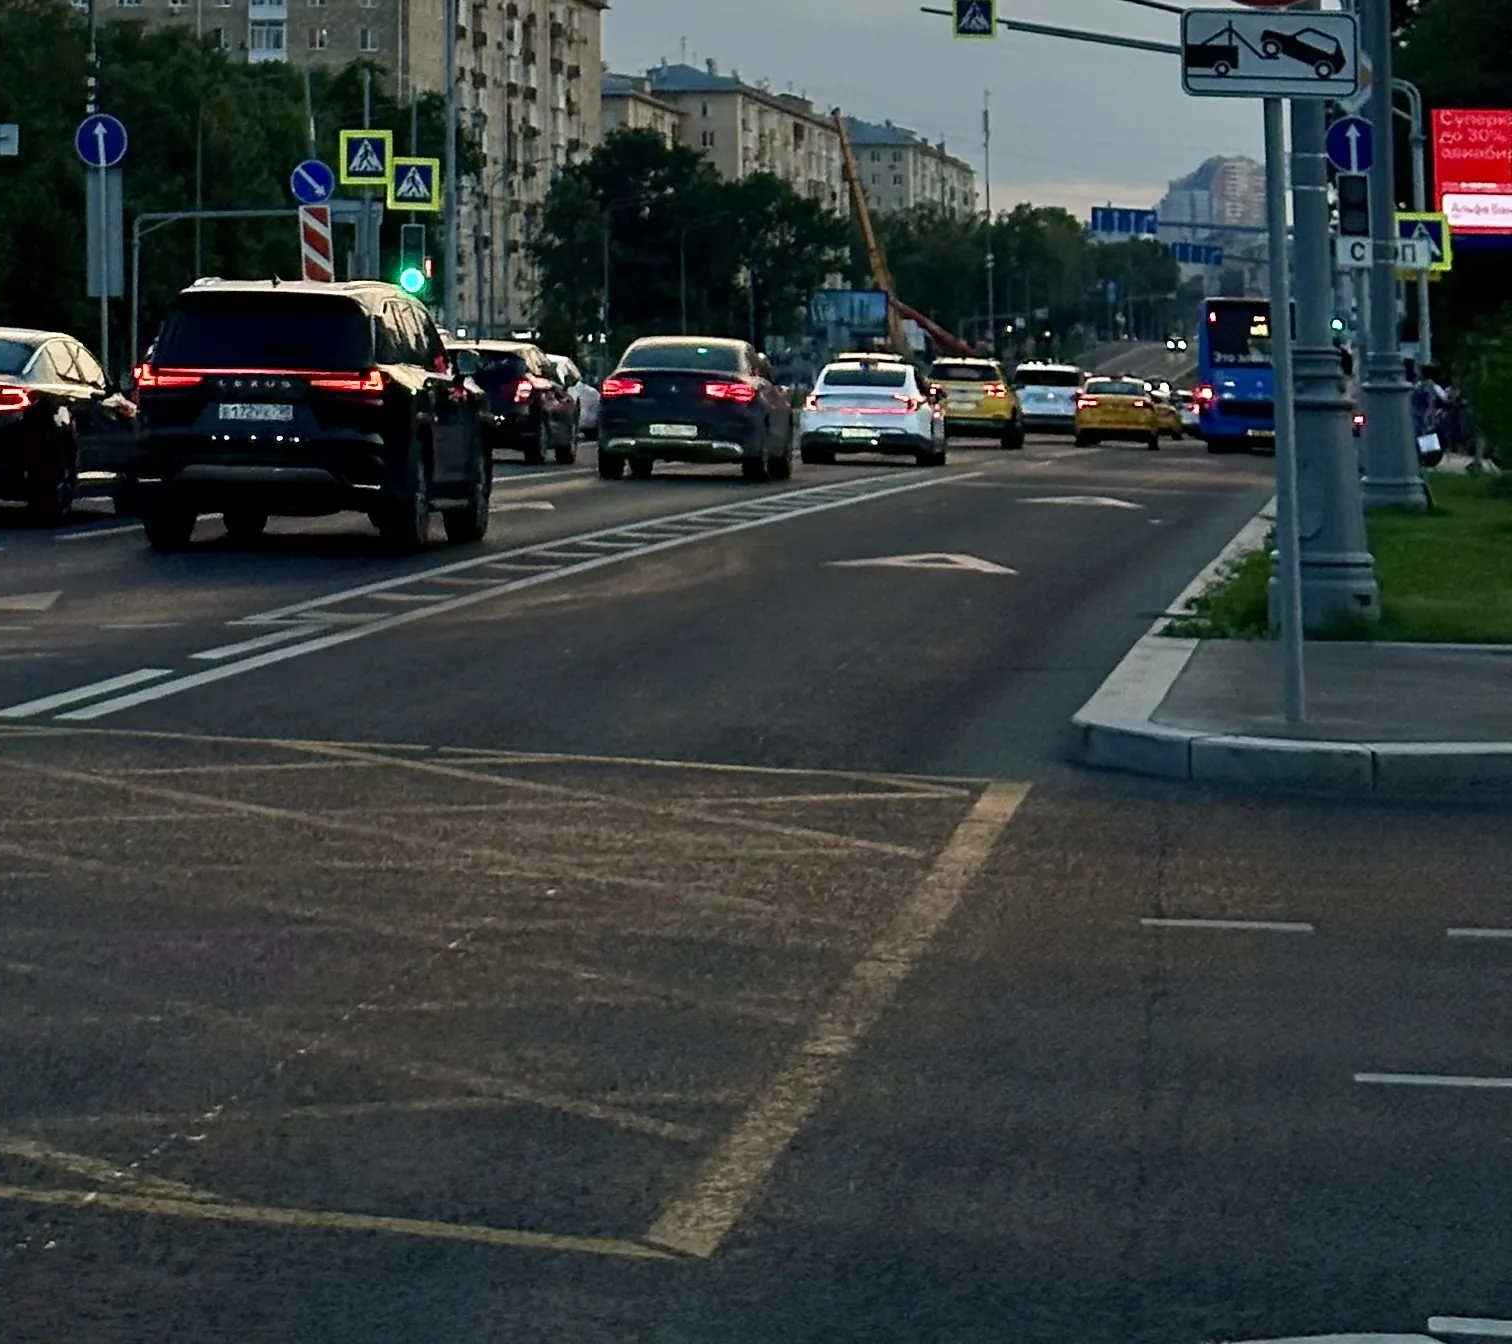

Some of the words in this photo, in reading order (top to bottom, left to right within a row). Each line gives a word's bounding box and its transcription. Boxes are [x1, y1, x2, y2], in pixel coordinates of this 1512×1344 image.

[1439, 130, 1463, 144] до
[1468, 127, 1507, 143] 30%
[1350, 242, 1416, 262] СП
[218, 379, 291, 388] LEXUS
